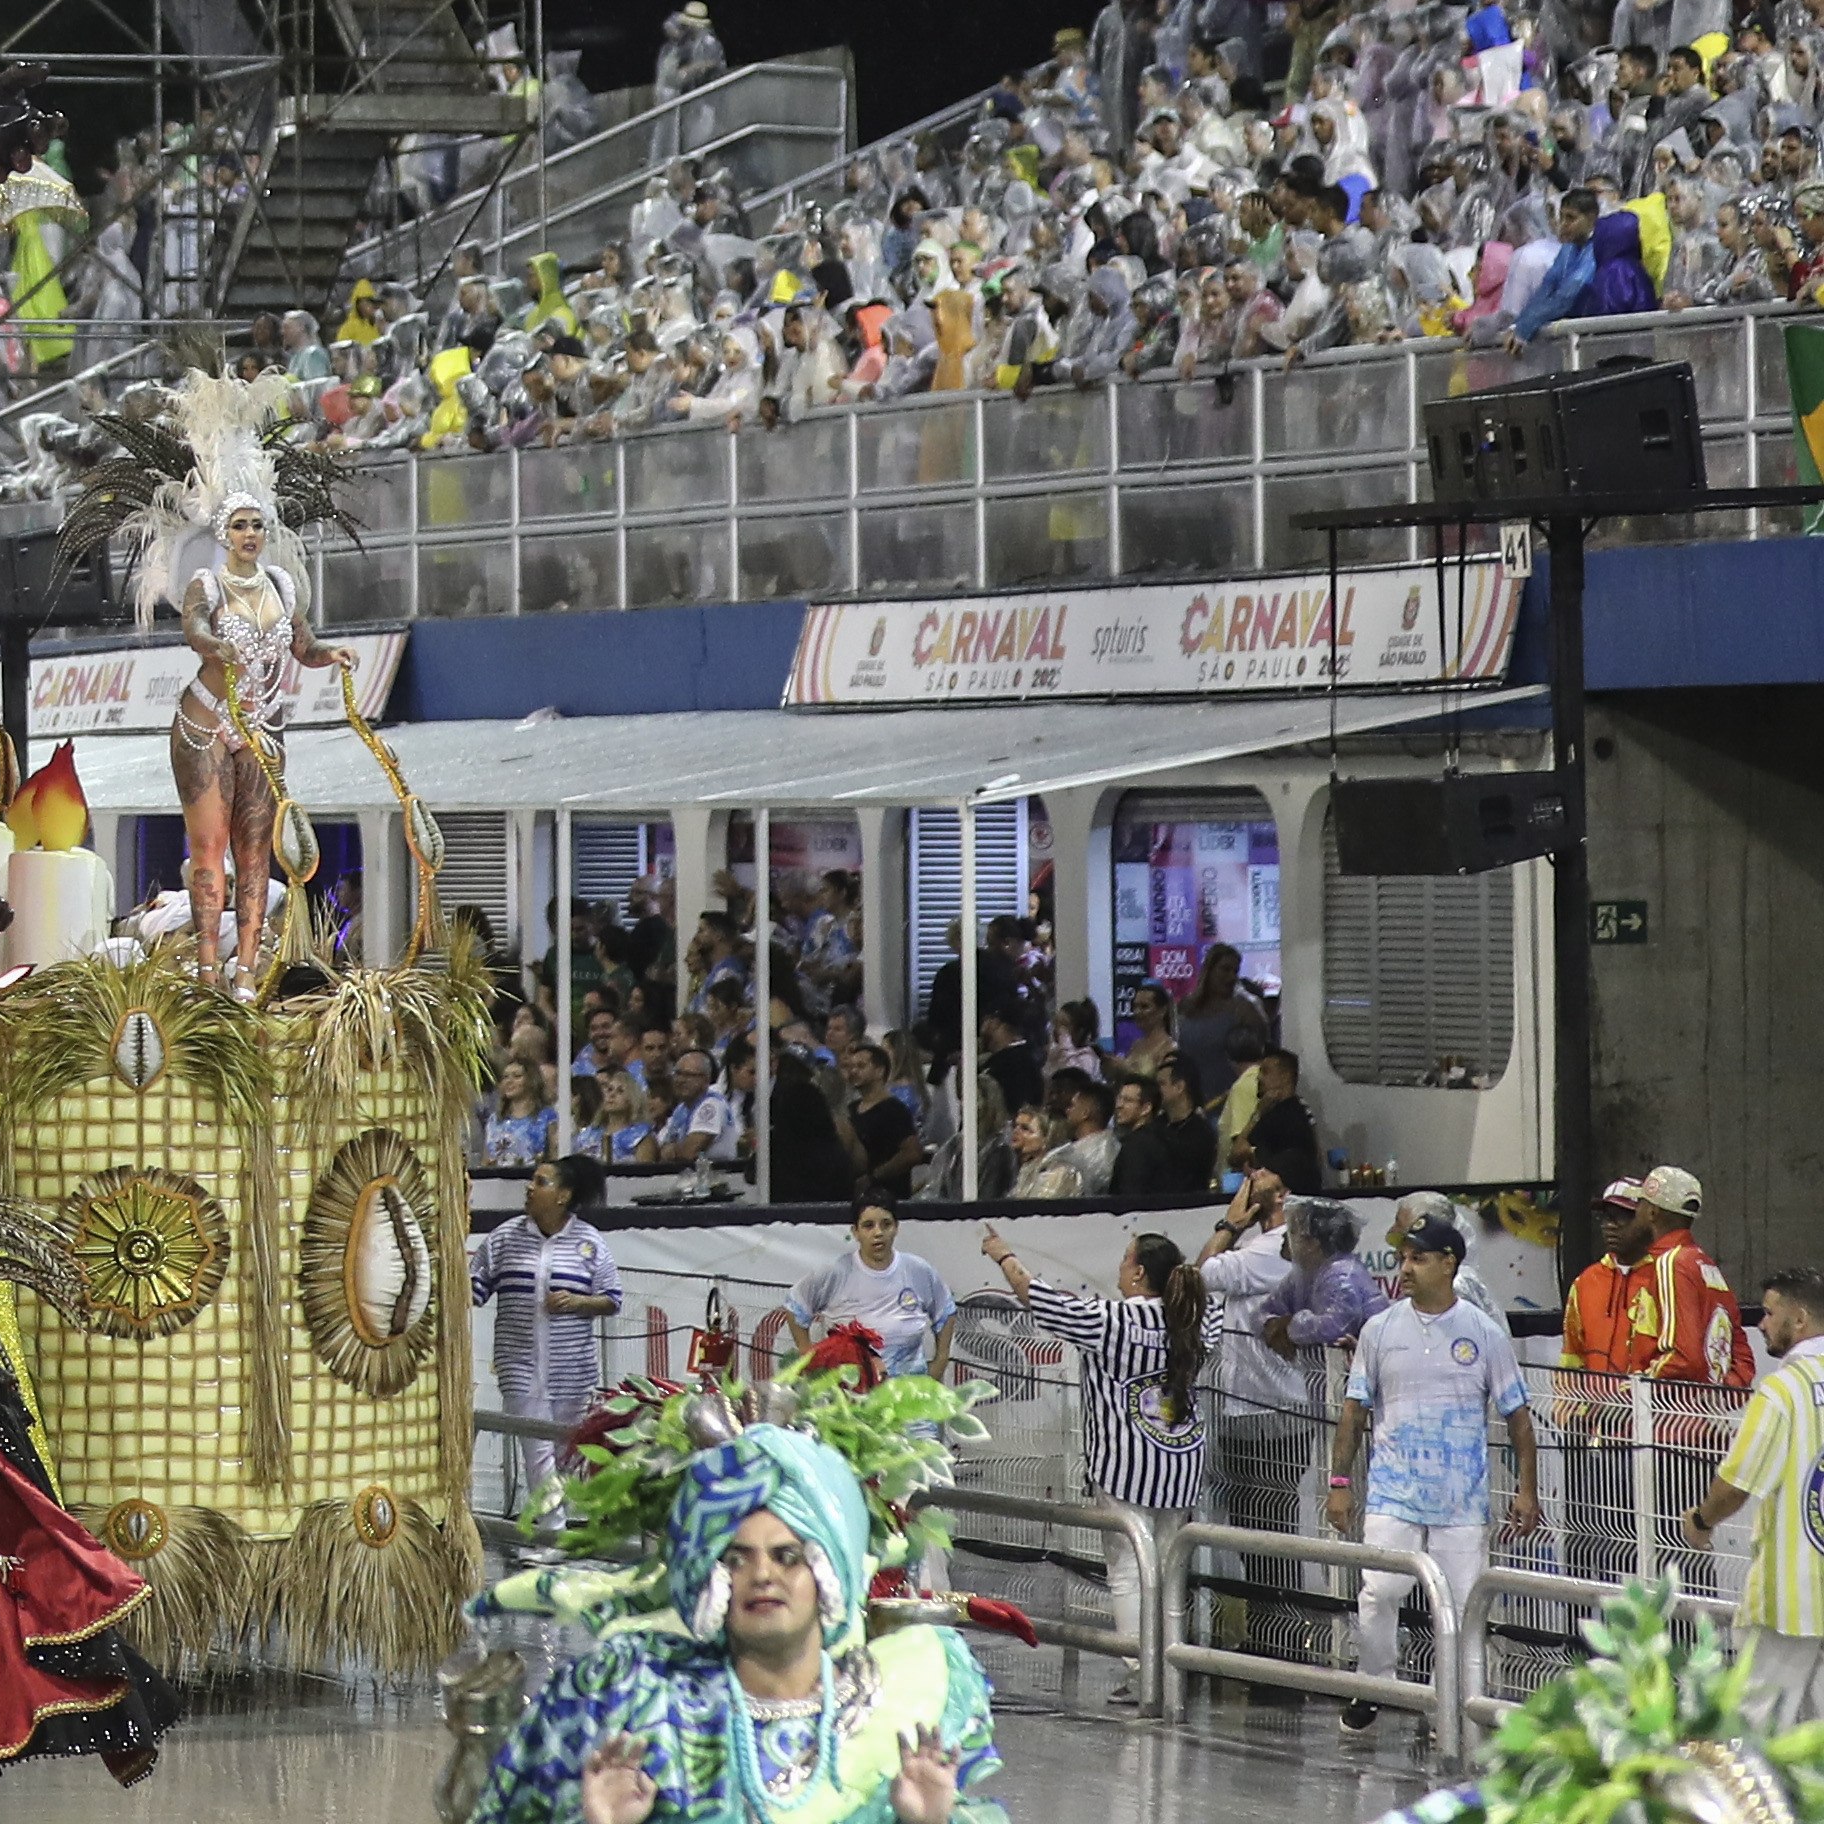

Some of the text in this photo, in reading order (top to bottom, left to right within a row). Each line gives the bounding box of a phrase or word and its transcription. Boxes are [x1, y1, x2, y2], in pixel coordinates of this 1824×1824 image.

[1504, 531, 1528, 571] 41
[911, 605, 1068, 670] CARNAVAL
[1180, 587, 1356, 659] CARNAVAL
[33, 660, 135, 711] CARNAVAL
[968, 668, 1023, 690] PAULO
[1246, 654, 1307, 680] PAULO
[1154, 963, 1194, 979] BOSCO
